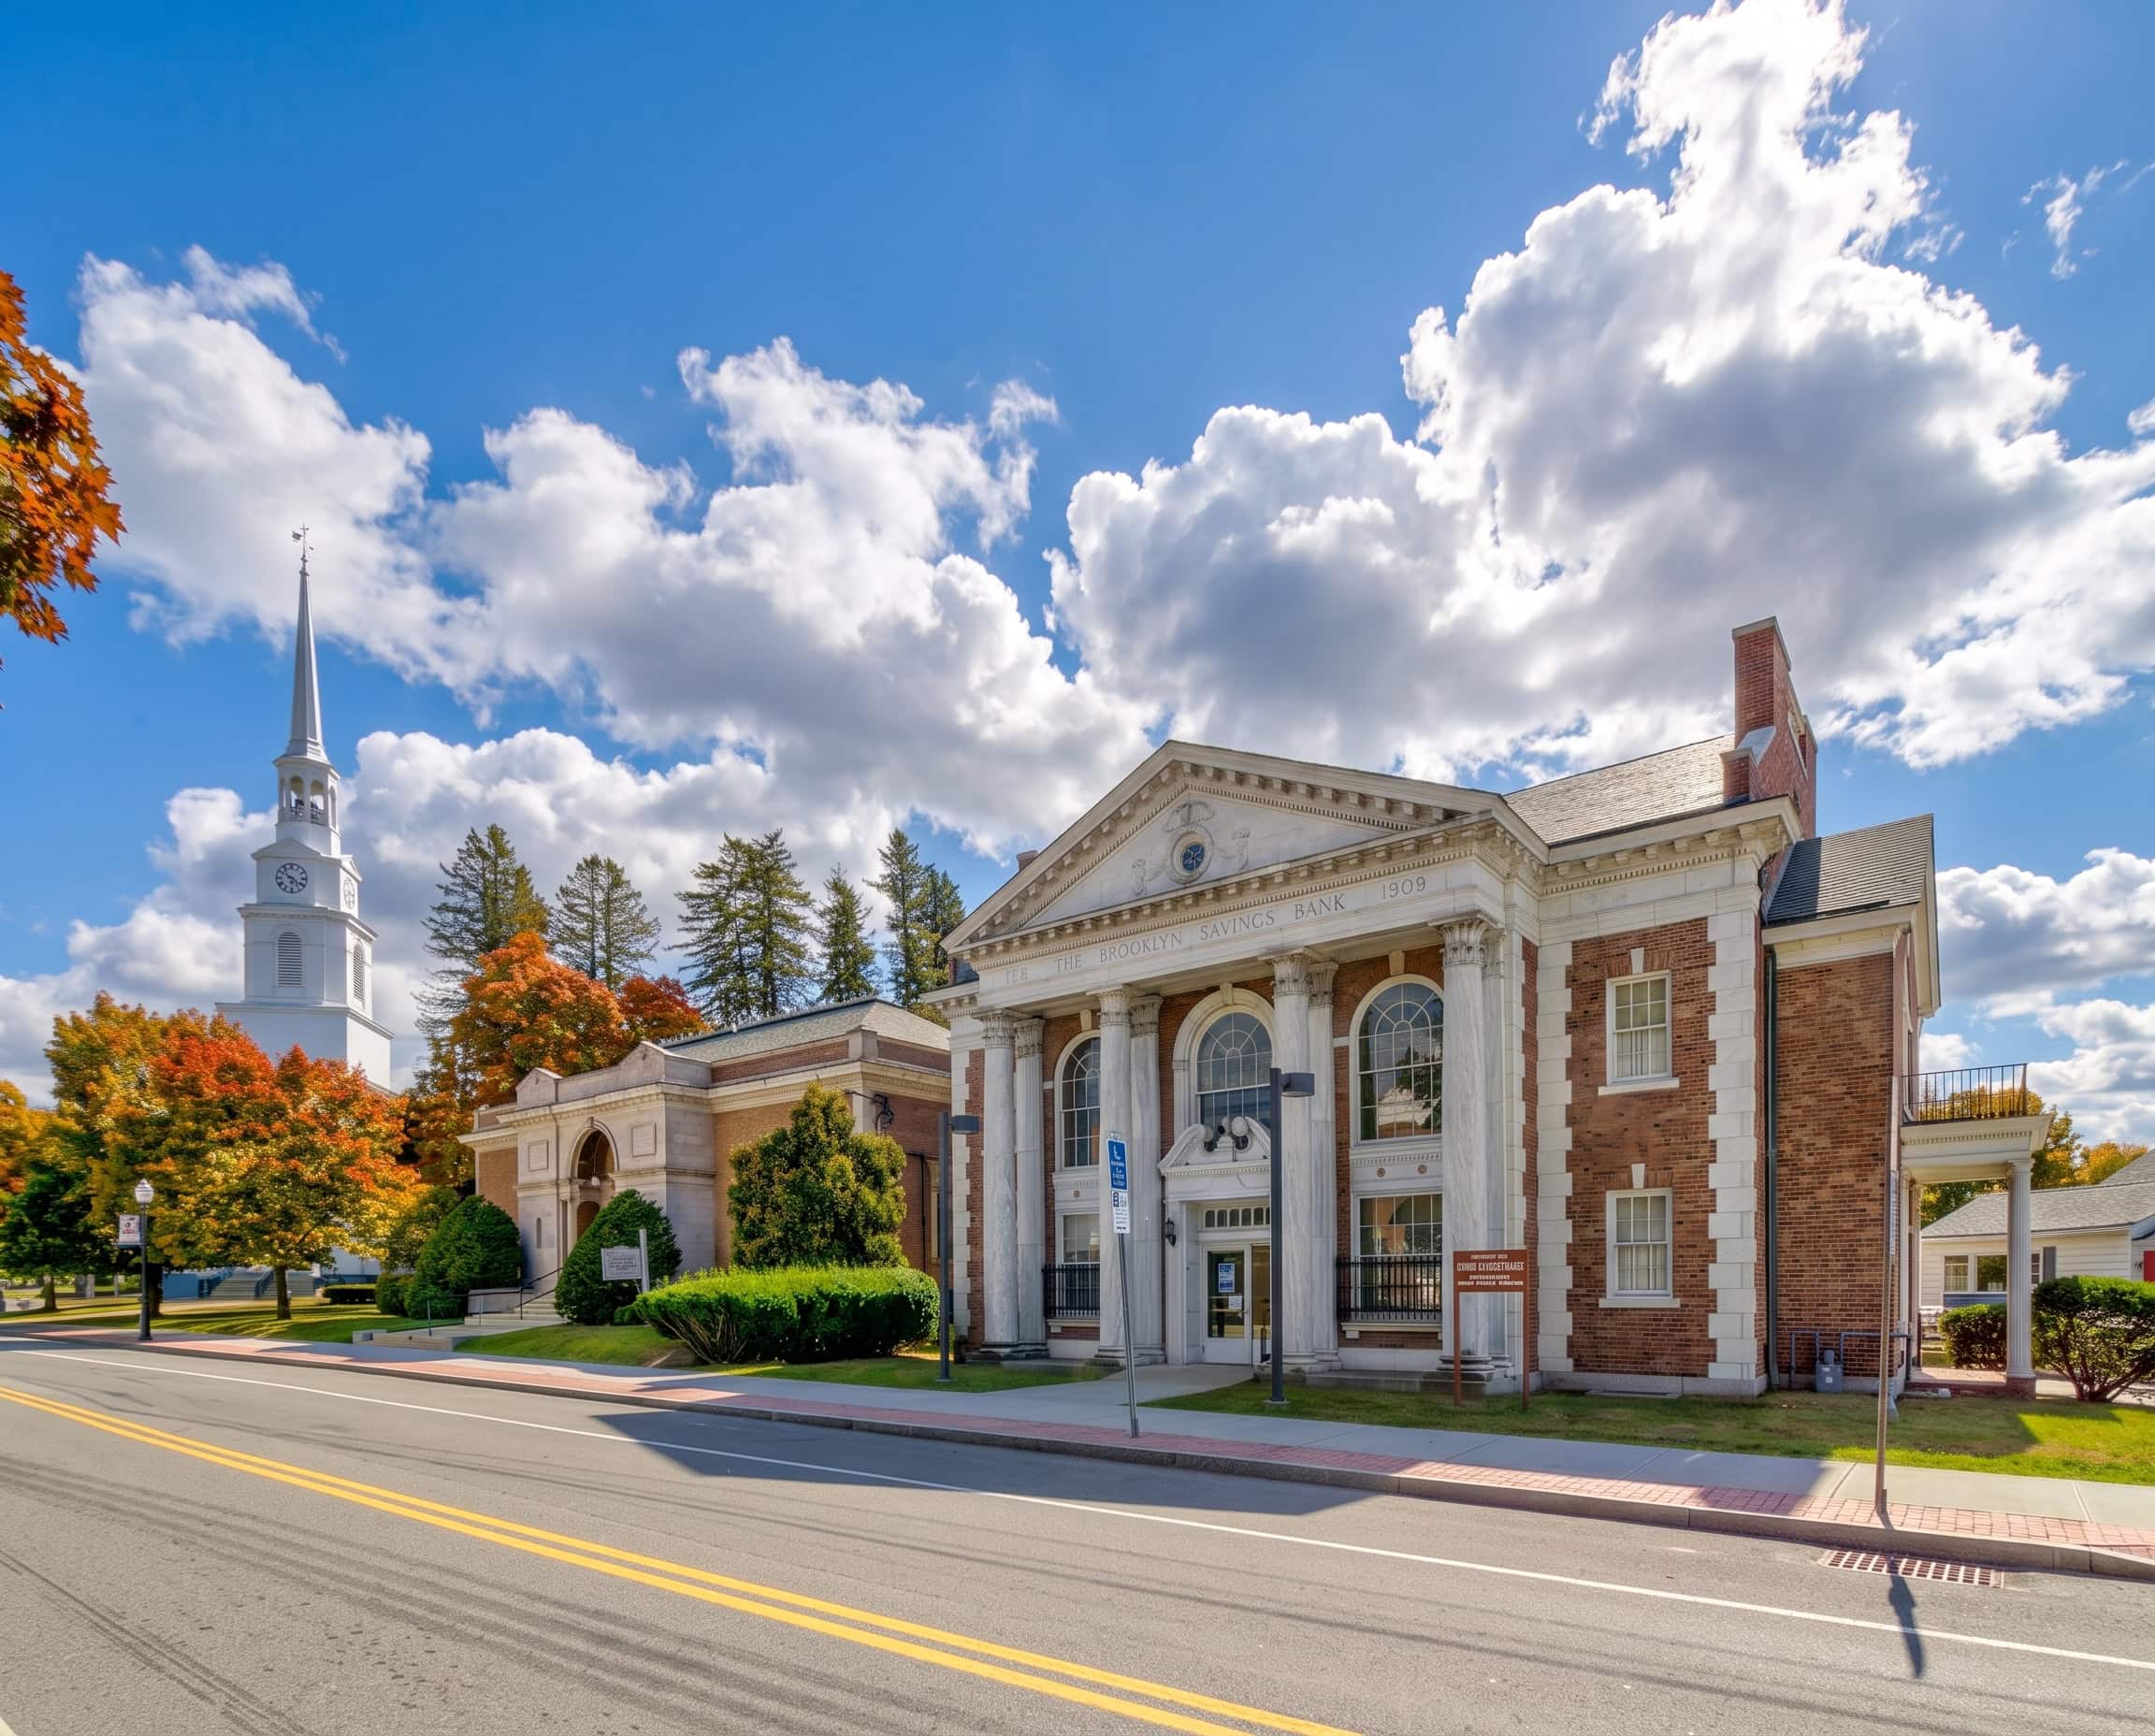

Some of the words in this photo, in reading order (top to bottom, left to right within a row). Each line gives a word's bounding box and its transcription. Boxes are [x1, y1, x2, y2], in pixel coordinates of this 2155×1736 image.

[1054, 954, 1083, 974] THE
[1099, 931, 1183, 962] BROOKLYN
[1200, 909, 1275, 941] SAVINGS
[1294, 893, 1346, 920] BANK
[1381, 875, 1426, 900] 1909
